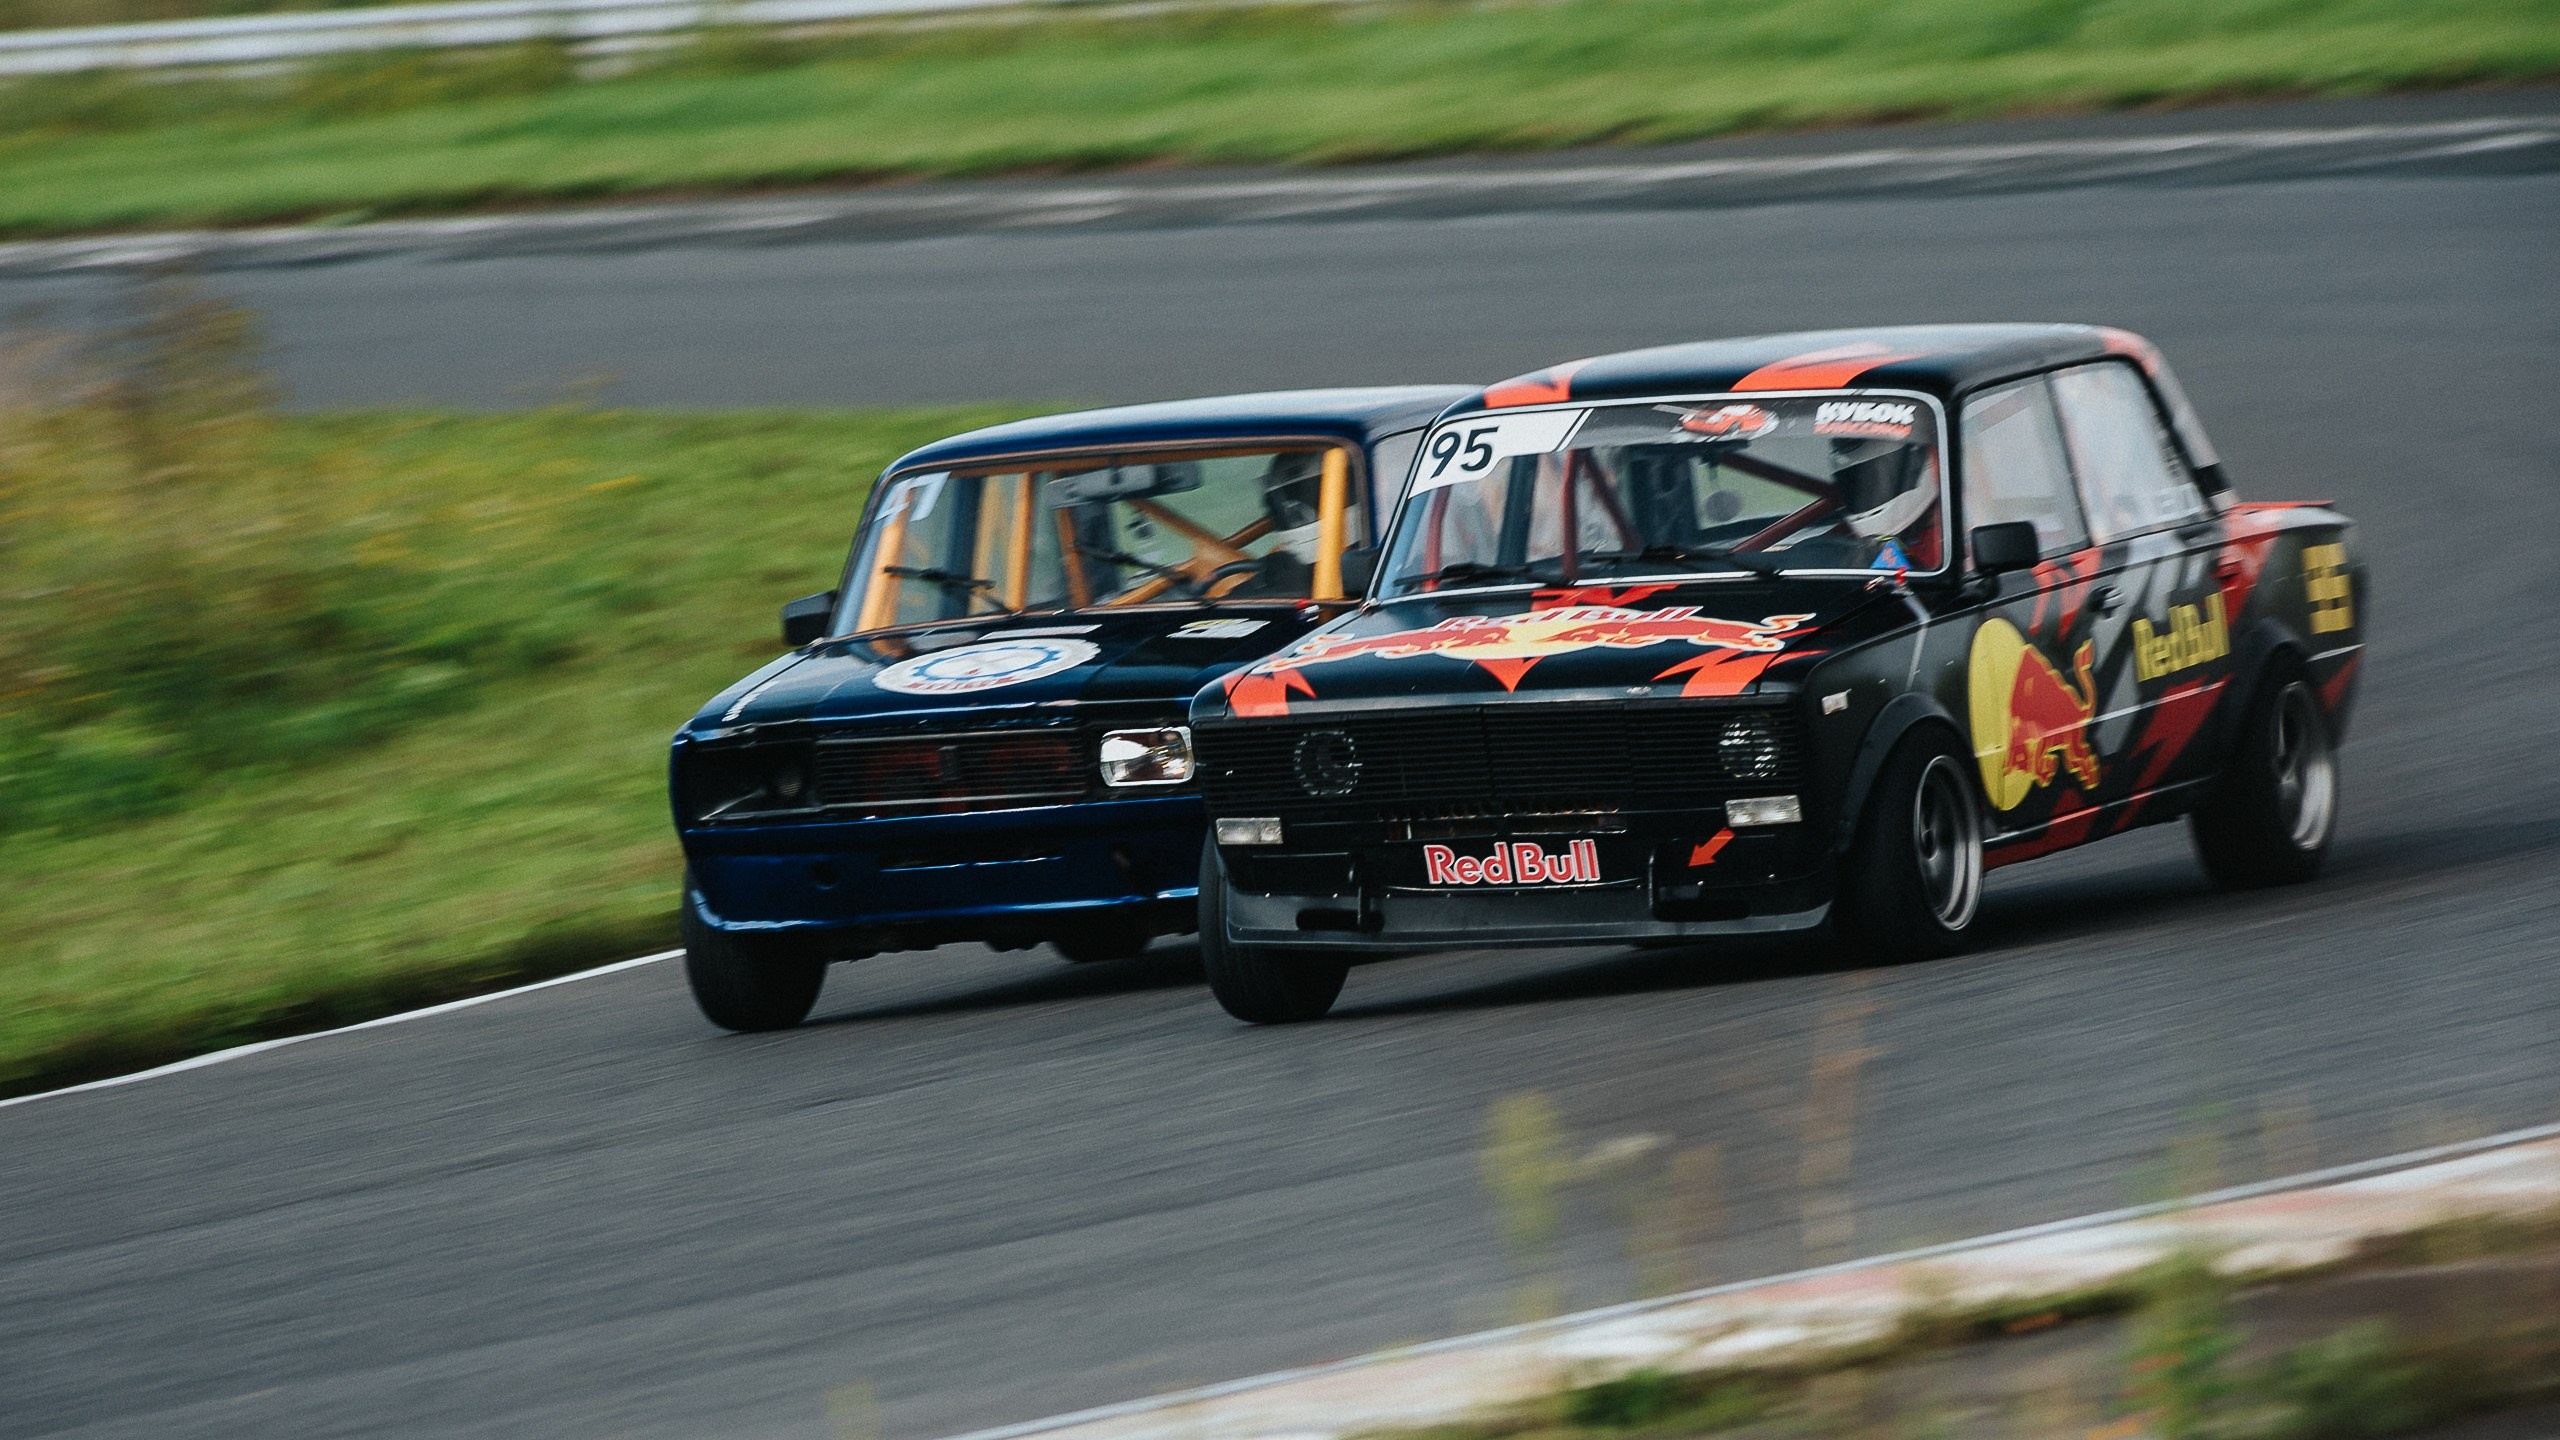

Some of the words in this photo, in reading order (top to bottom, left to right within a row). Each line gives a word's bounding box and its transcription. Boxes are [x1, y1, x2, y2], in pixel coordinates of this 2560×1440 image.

[1430, 425, 1500, 480] 95
[1424, 841, 1513, 884] Red
[1512, 839, 1600, 883] Bull
